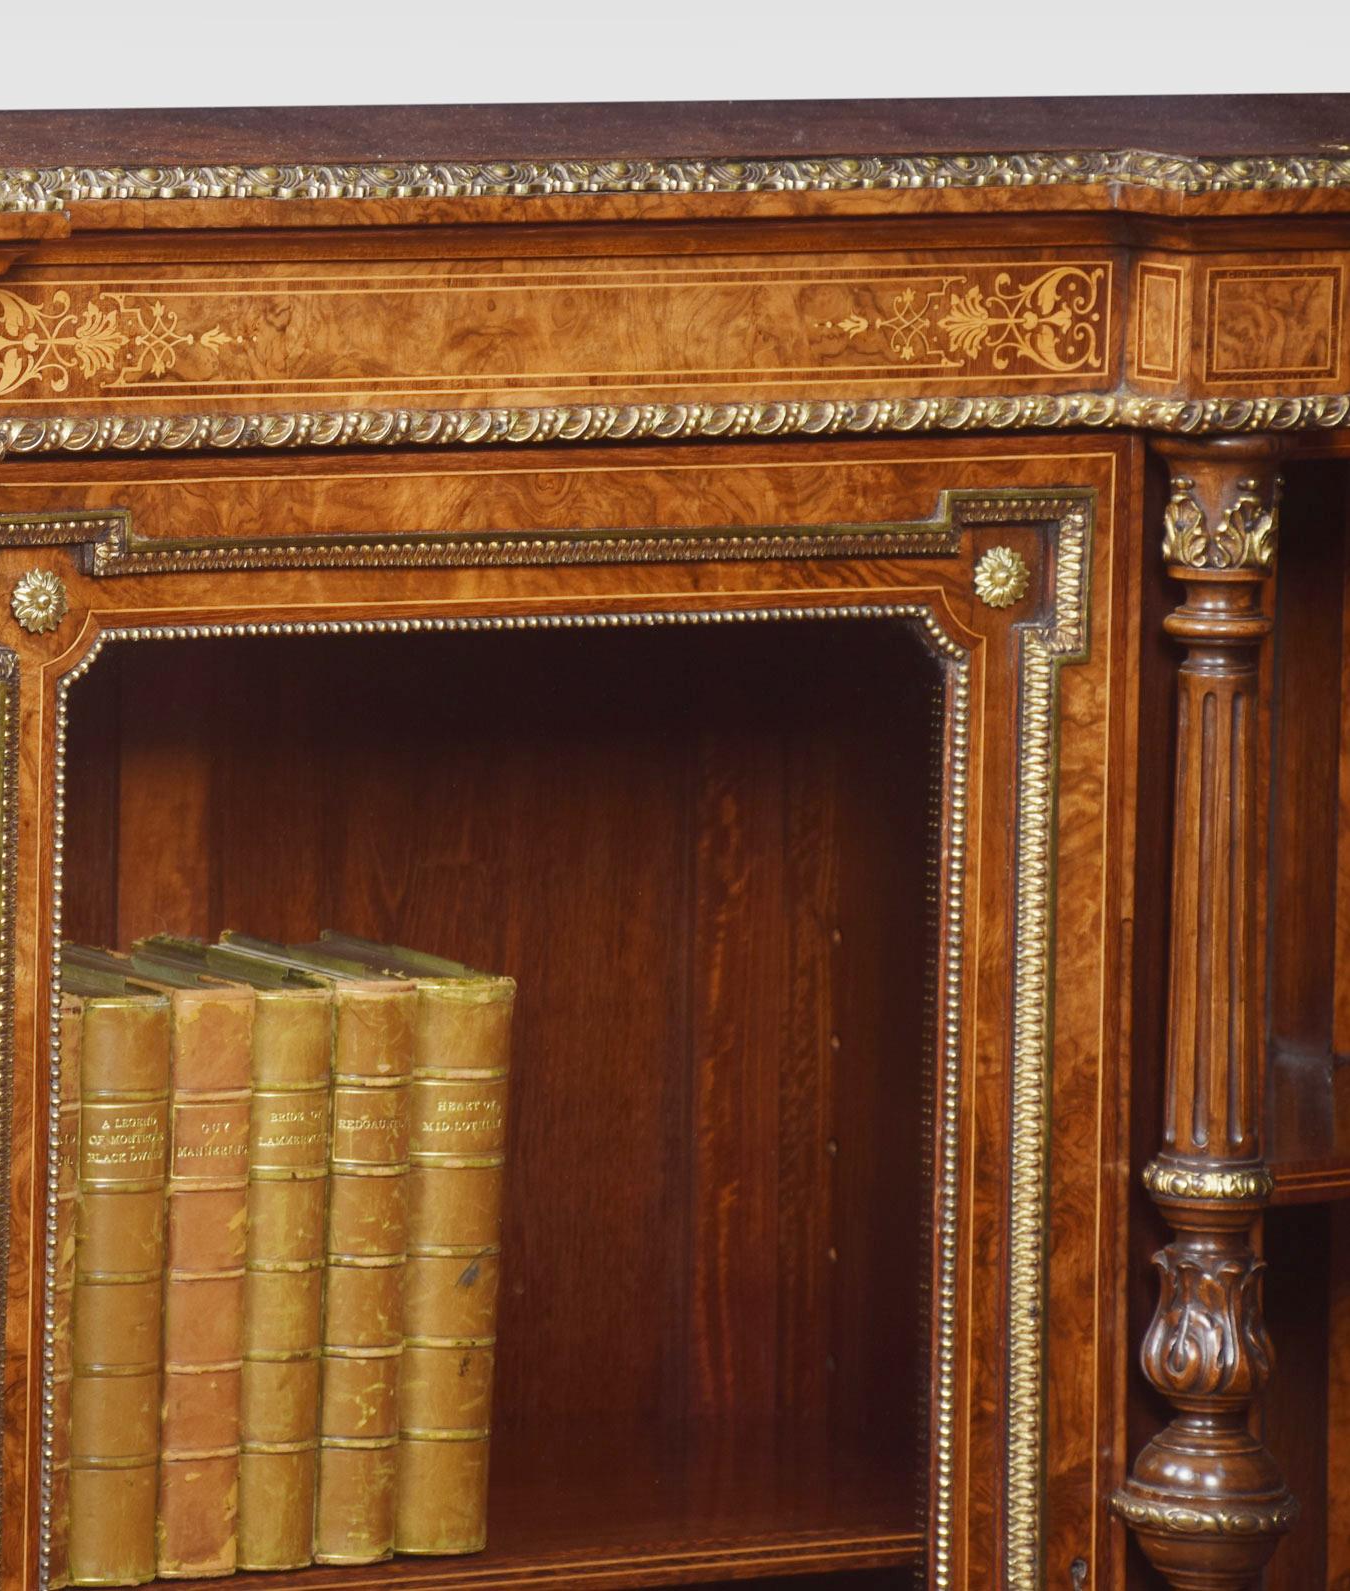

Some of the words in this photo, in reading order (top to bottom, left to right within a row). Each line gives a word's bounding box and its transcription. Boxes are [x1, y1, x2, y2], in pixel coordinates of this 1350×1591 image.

[437, 1101, 481, 1112] HEART
[270, 1111, 305, 1122] BRIDE
[101, 1119, 111, 1130] A
[115, 1117, 158, 1129] LEGEND
[201, 1122, 230, 1134] GUY
[88, 1134, 105, 1146] OF
[177, 1144, 248, 1158] MANNERING
[86, 1152, 127, 1164] BLACK
